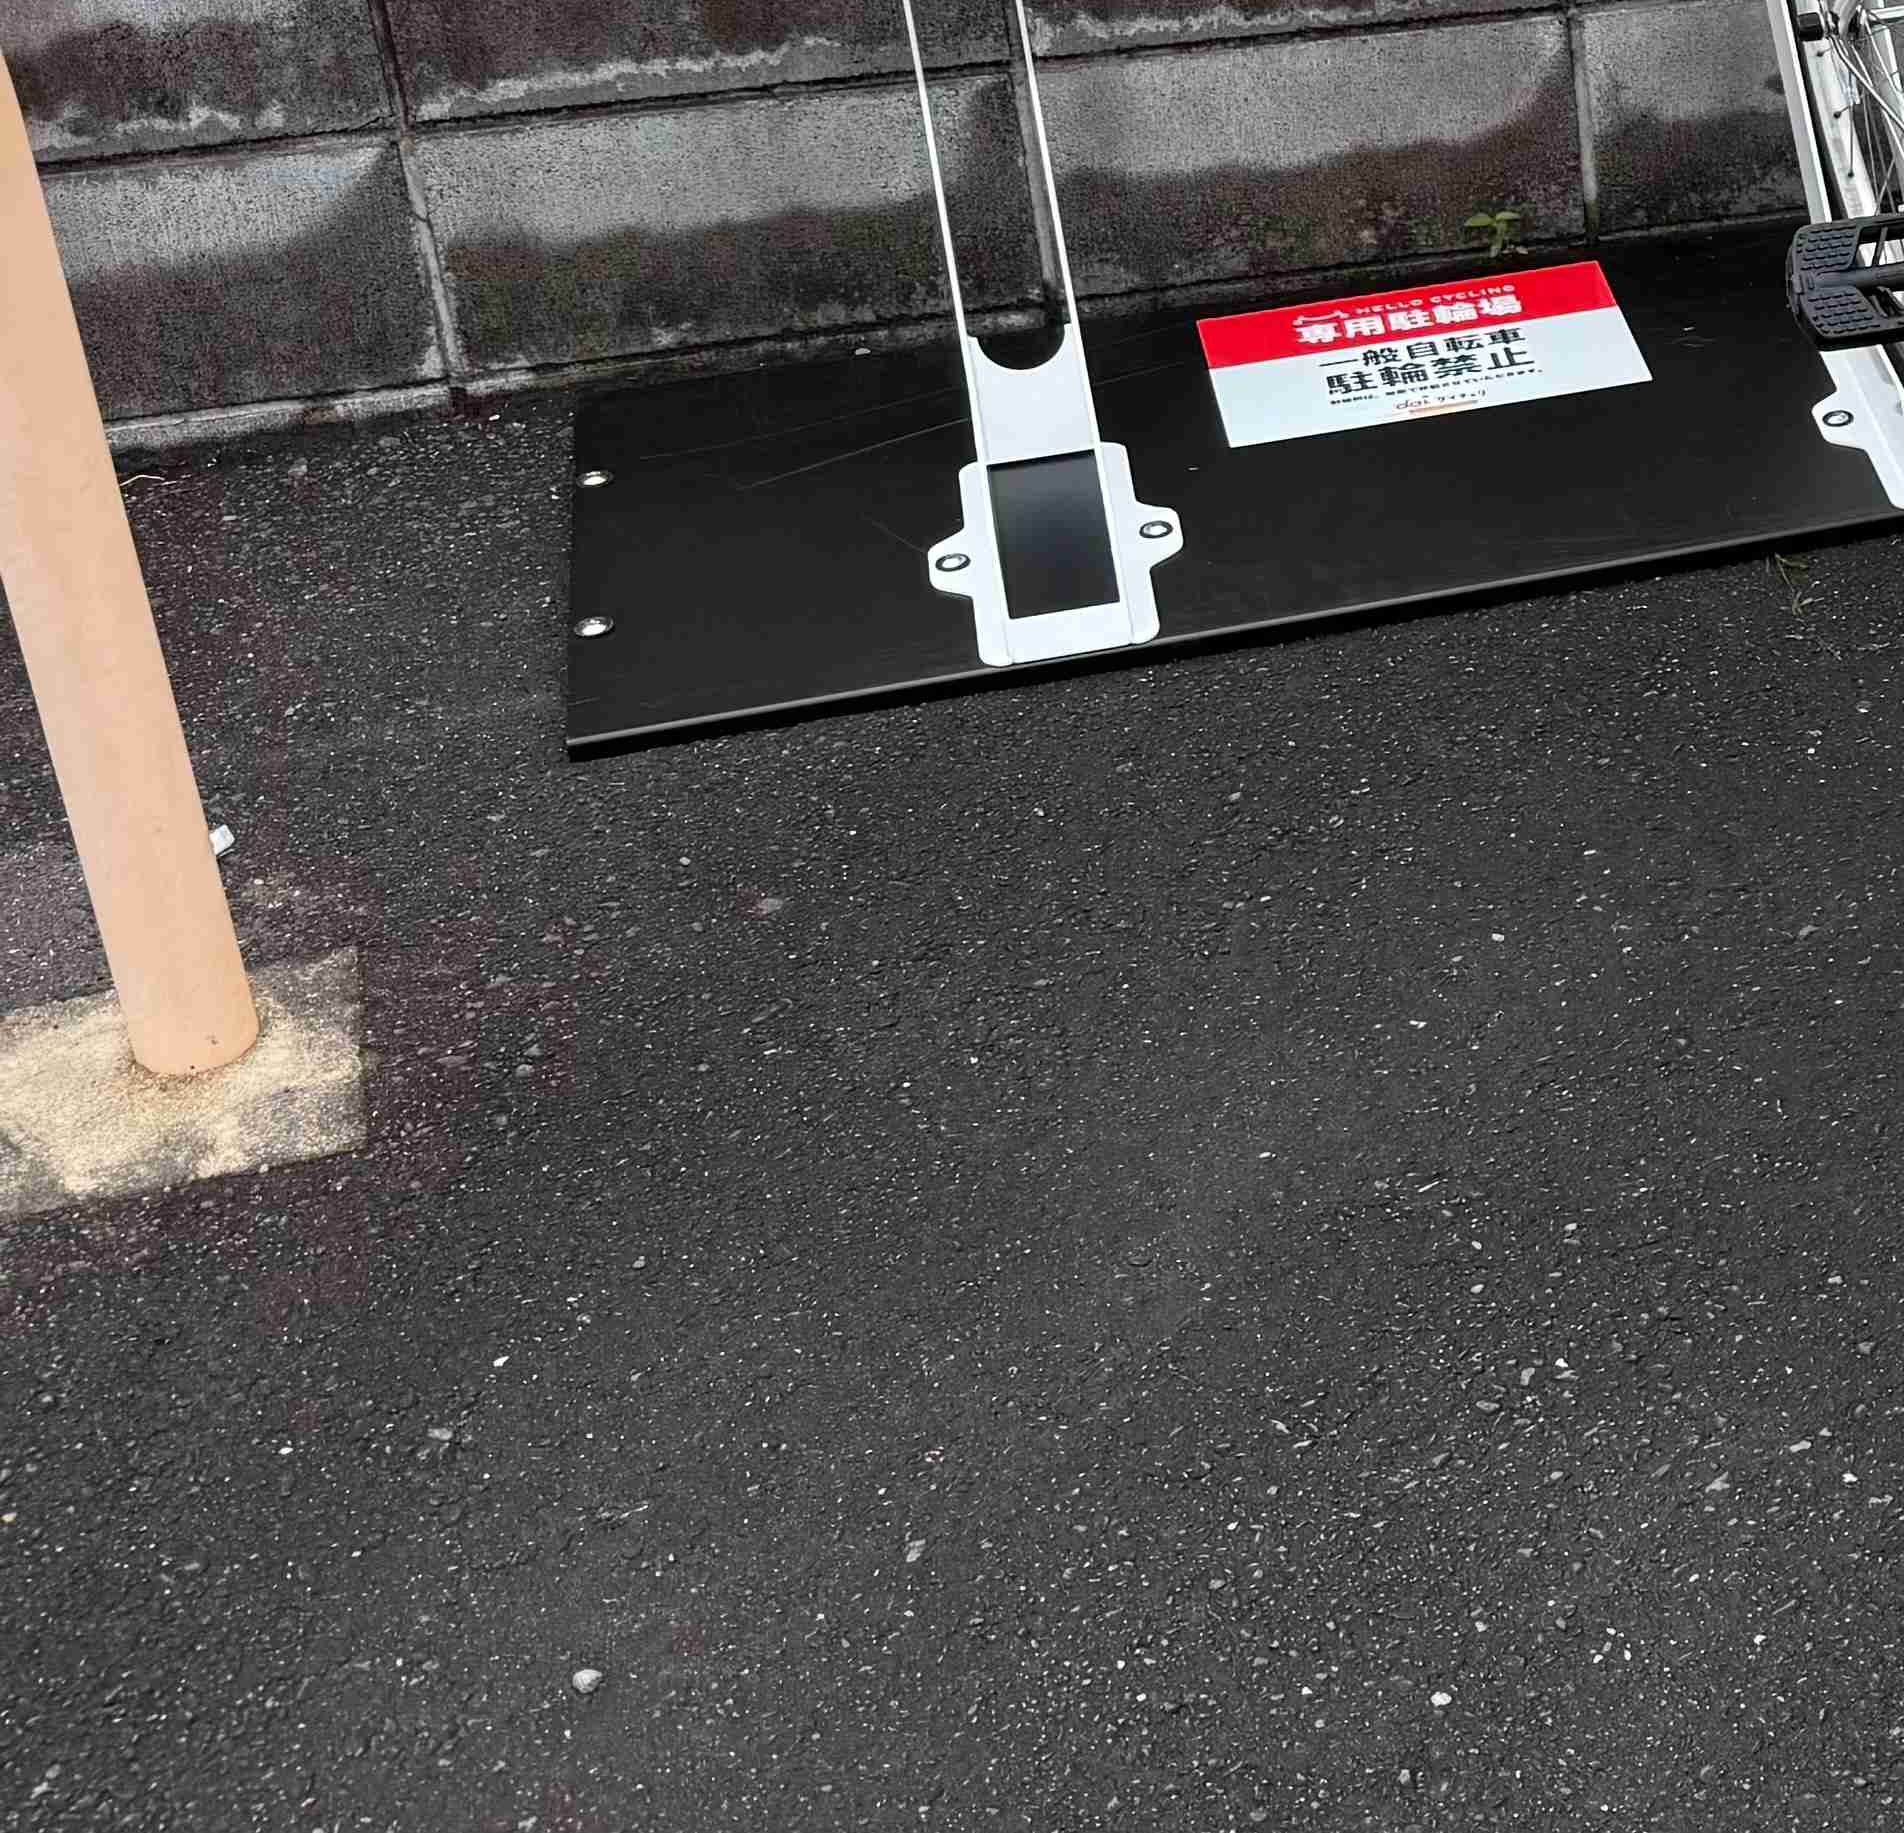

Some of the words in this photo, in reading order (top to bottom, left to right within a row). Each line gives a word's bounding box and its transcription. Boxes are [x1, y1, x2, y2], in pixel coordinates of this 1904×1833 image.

[1296, 294, 1522, 344] 専用駐輪場
[1319, 328, 1525, 367] 一般自転車
[1327, 347, 1535, 394] 駐輪禁止
